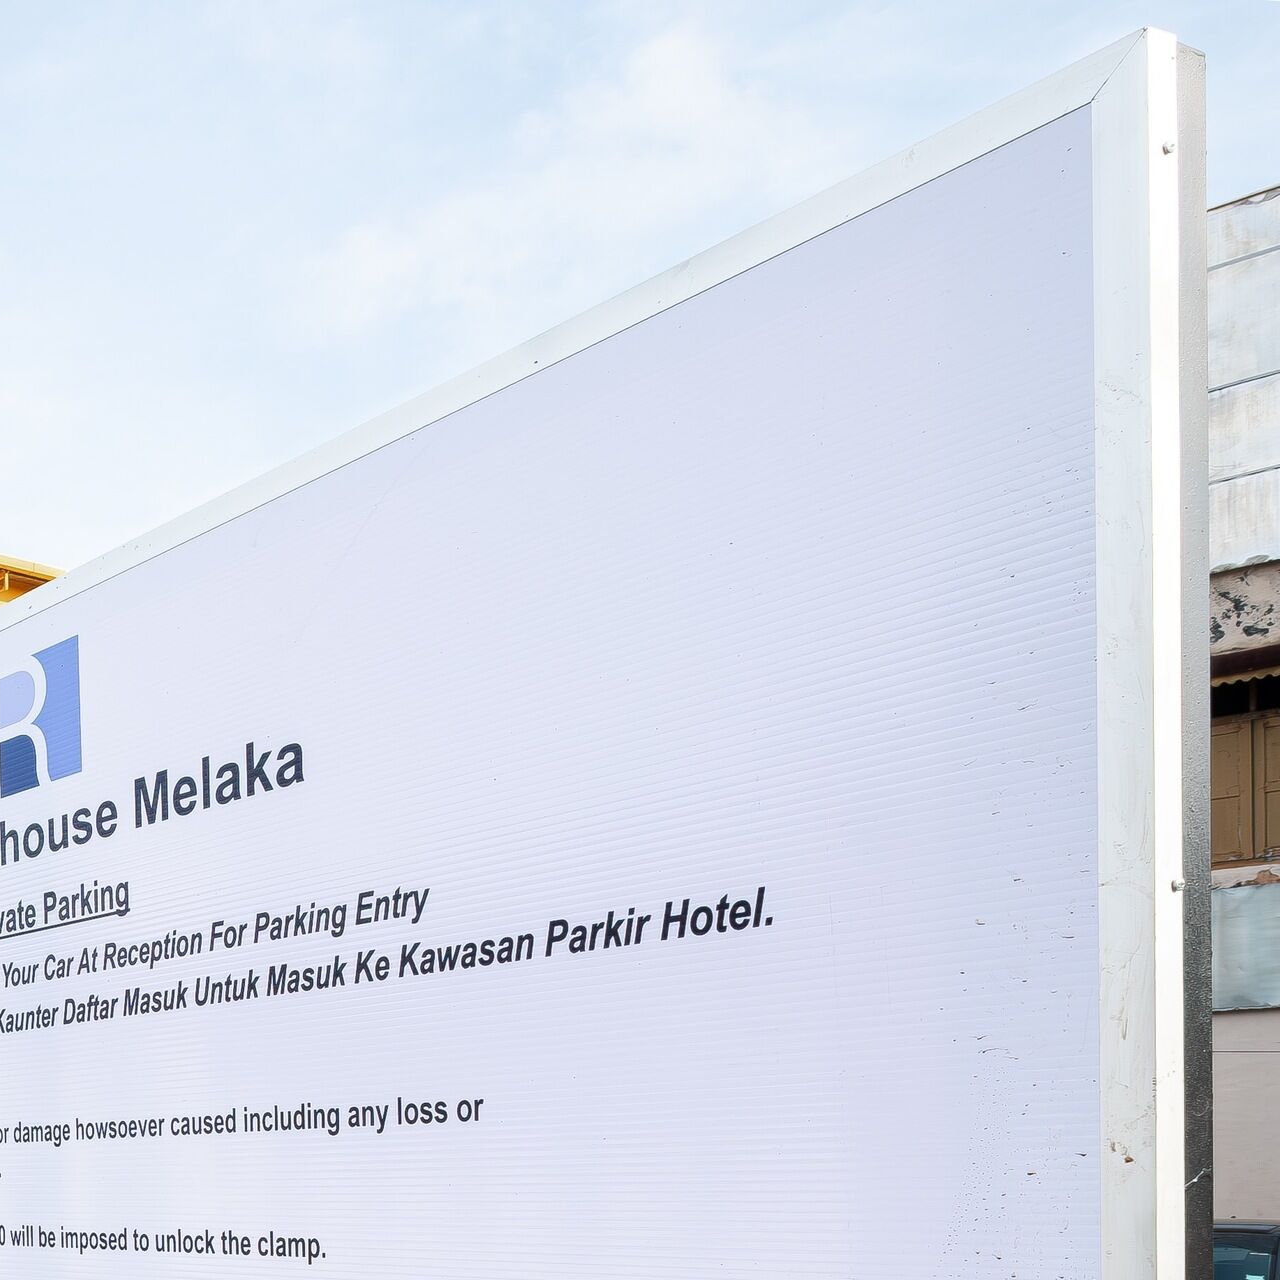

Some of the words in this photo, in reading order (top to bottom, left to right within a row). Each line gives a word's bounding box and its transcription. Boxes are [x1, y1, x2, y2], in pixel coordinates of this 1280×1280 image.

[134, 741, 304, 828] Melaka
[1, 961, 39, 988] Your
[43, 953, 74, 980] Car
[76, 946, 98, 975] At
[102, 929, 202, 970] Reception
[208, 919, 247, 951] For
[253, 901, 347, 943] Parking
[354, 886, 429, 925] Entry
[43, 879, 129, 924] Parking
[62, 993, 119, 1025] Daftar
[122, 980, 188, 1016] Masuk
[194, 968, 260, 1006] Untuk
[266, 954, 347, 996] Masuk
[353, 948, 390, 983] Ke
[398, 932, 534, 978] Kawasan
[544, 907, 651, 957] Parkir
[660, 885, 773, 940] Hotel.
[13, 1121, 70, 1147] damage
[75, 1117, 165, 1140] howsoever
[170, 1107, 236, 1136] caused
[243, 1101, 339, 1135] including
[347, 1104, 388, 1133] any
[397, 1096, 447, 1124] loss
[456, 1098, 484, 1121] or
